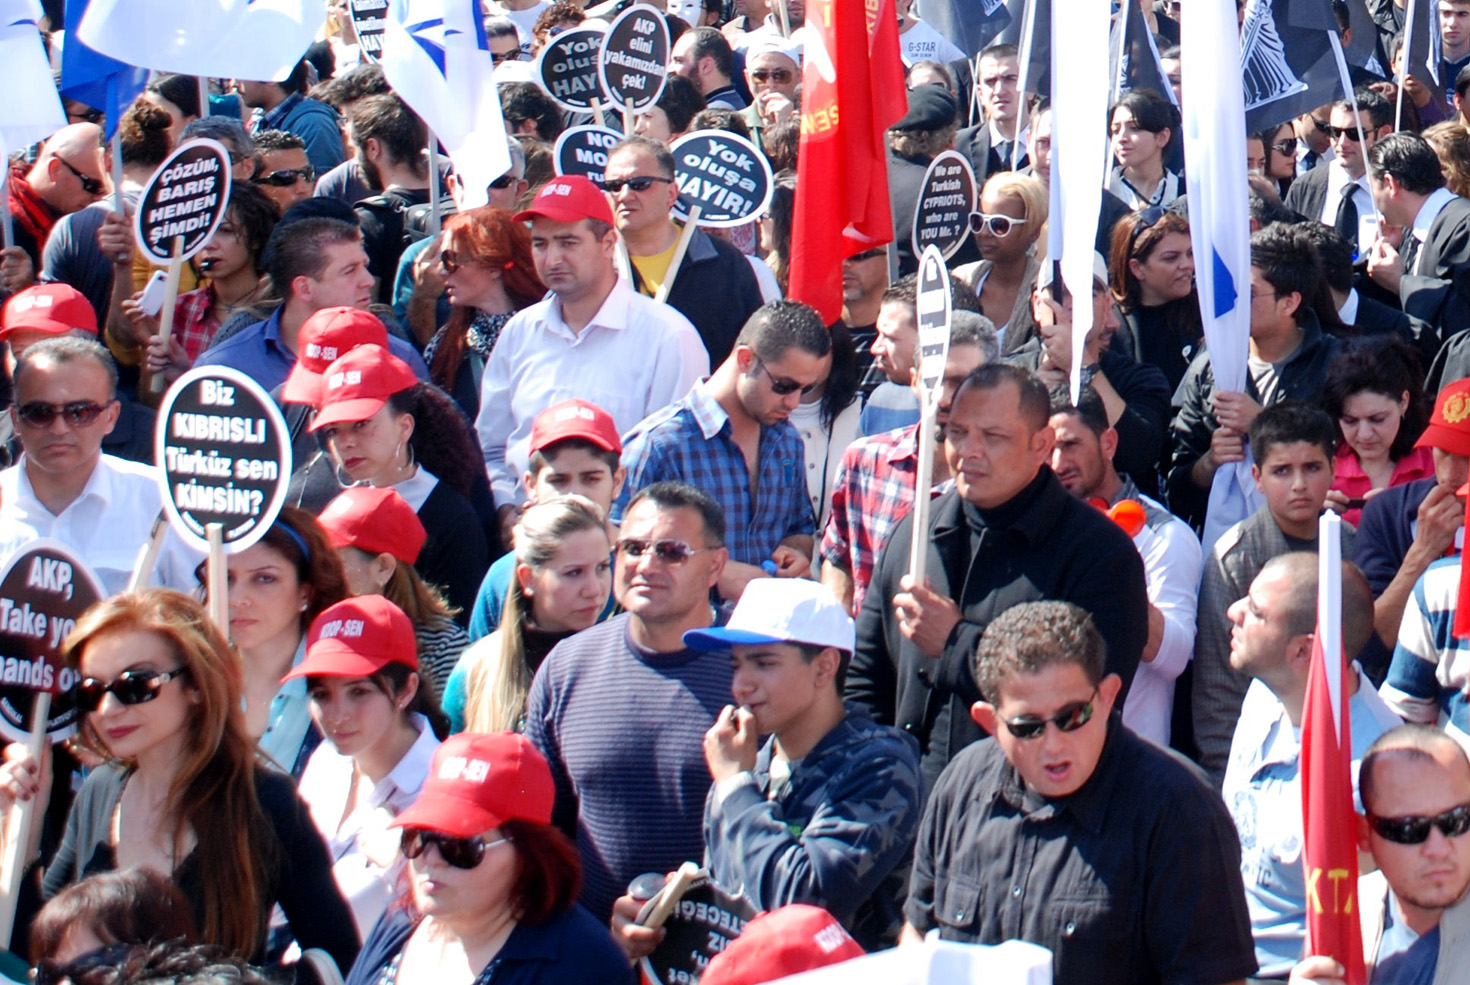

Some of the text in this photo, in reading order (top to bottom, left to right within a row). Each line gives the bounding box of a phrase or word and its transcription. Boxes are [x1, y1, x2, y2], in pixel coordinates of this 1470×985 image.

[633, 18, 655, 34] AKP
[559, 37, 601, 55] Yok
[629, 36, 653, 55] elini
[908, 42, 936, 52] G-STAR
[605, 50, 666, 77] yakamızdan
[622, 73, 647, 90] çek!
[587, 132, 618, 149] NO
[708, 138, 754, 172] Yok
[161, 157, 219, 186] ÇÖZÜM,
[683, 152, 757, 193] oluşa
[935, 165, 962, 177] We are
[158, 176, 215, 203] BARIŞ
[674, 170, 754, 218] HAYIR!
[931, 179, 961, 193] Turkish
[149, 193, 217, 223] HEMEN
[923, 194, 966, 209] CYPRIOTS,
[150, 212, 211, 244] ŞİMDİ!
[926, 212, 958, 224] who are
[921, 227, 937, 240] YOU
[201, 379, 235, 405] Biz
[174, 413, 266, 444] KIBRISLI
[166, 446, 278, 480] Türküz sen
[176, 478, 264, 515] KİMSİN?
[27, 555, 74, 601] AKP,
[0, 597, 76, 648] Take yo
[320, 619, 364, 639] KOOP-SEN
